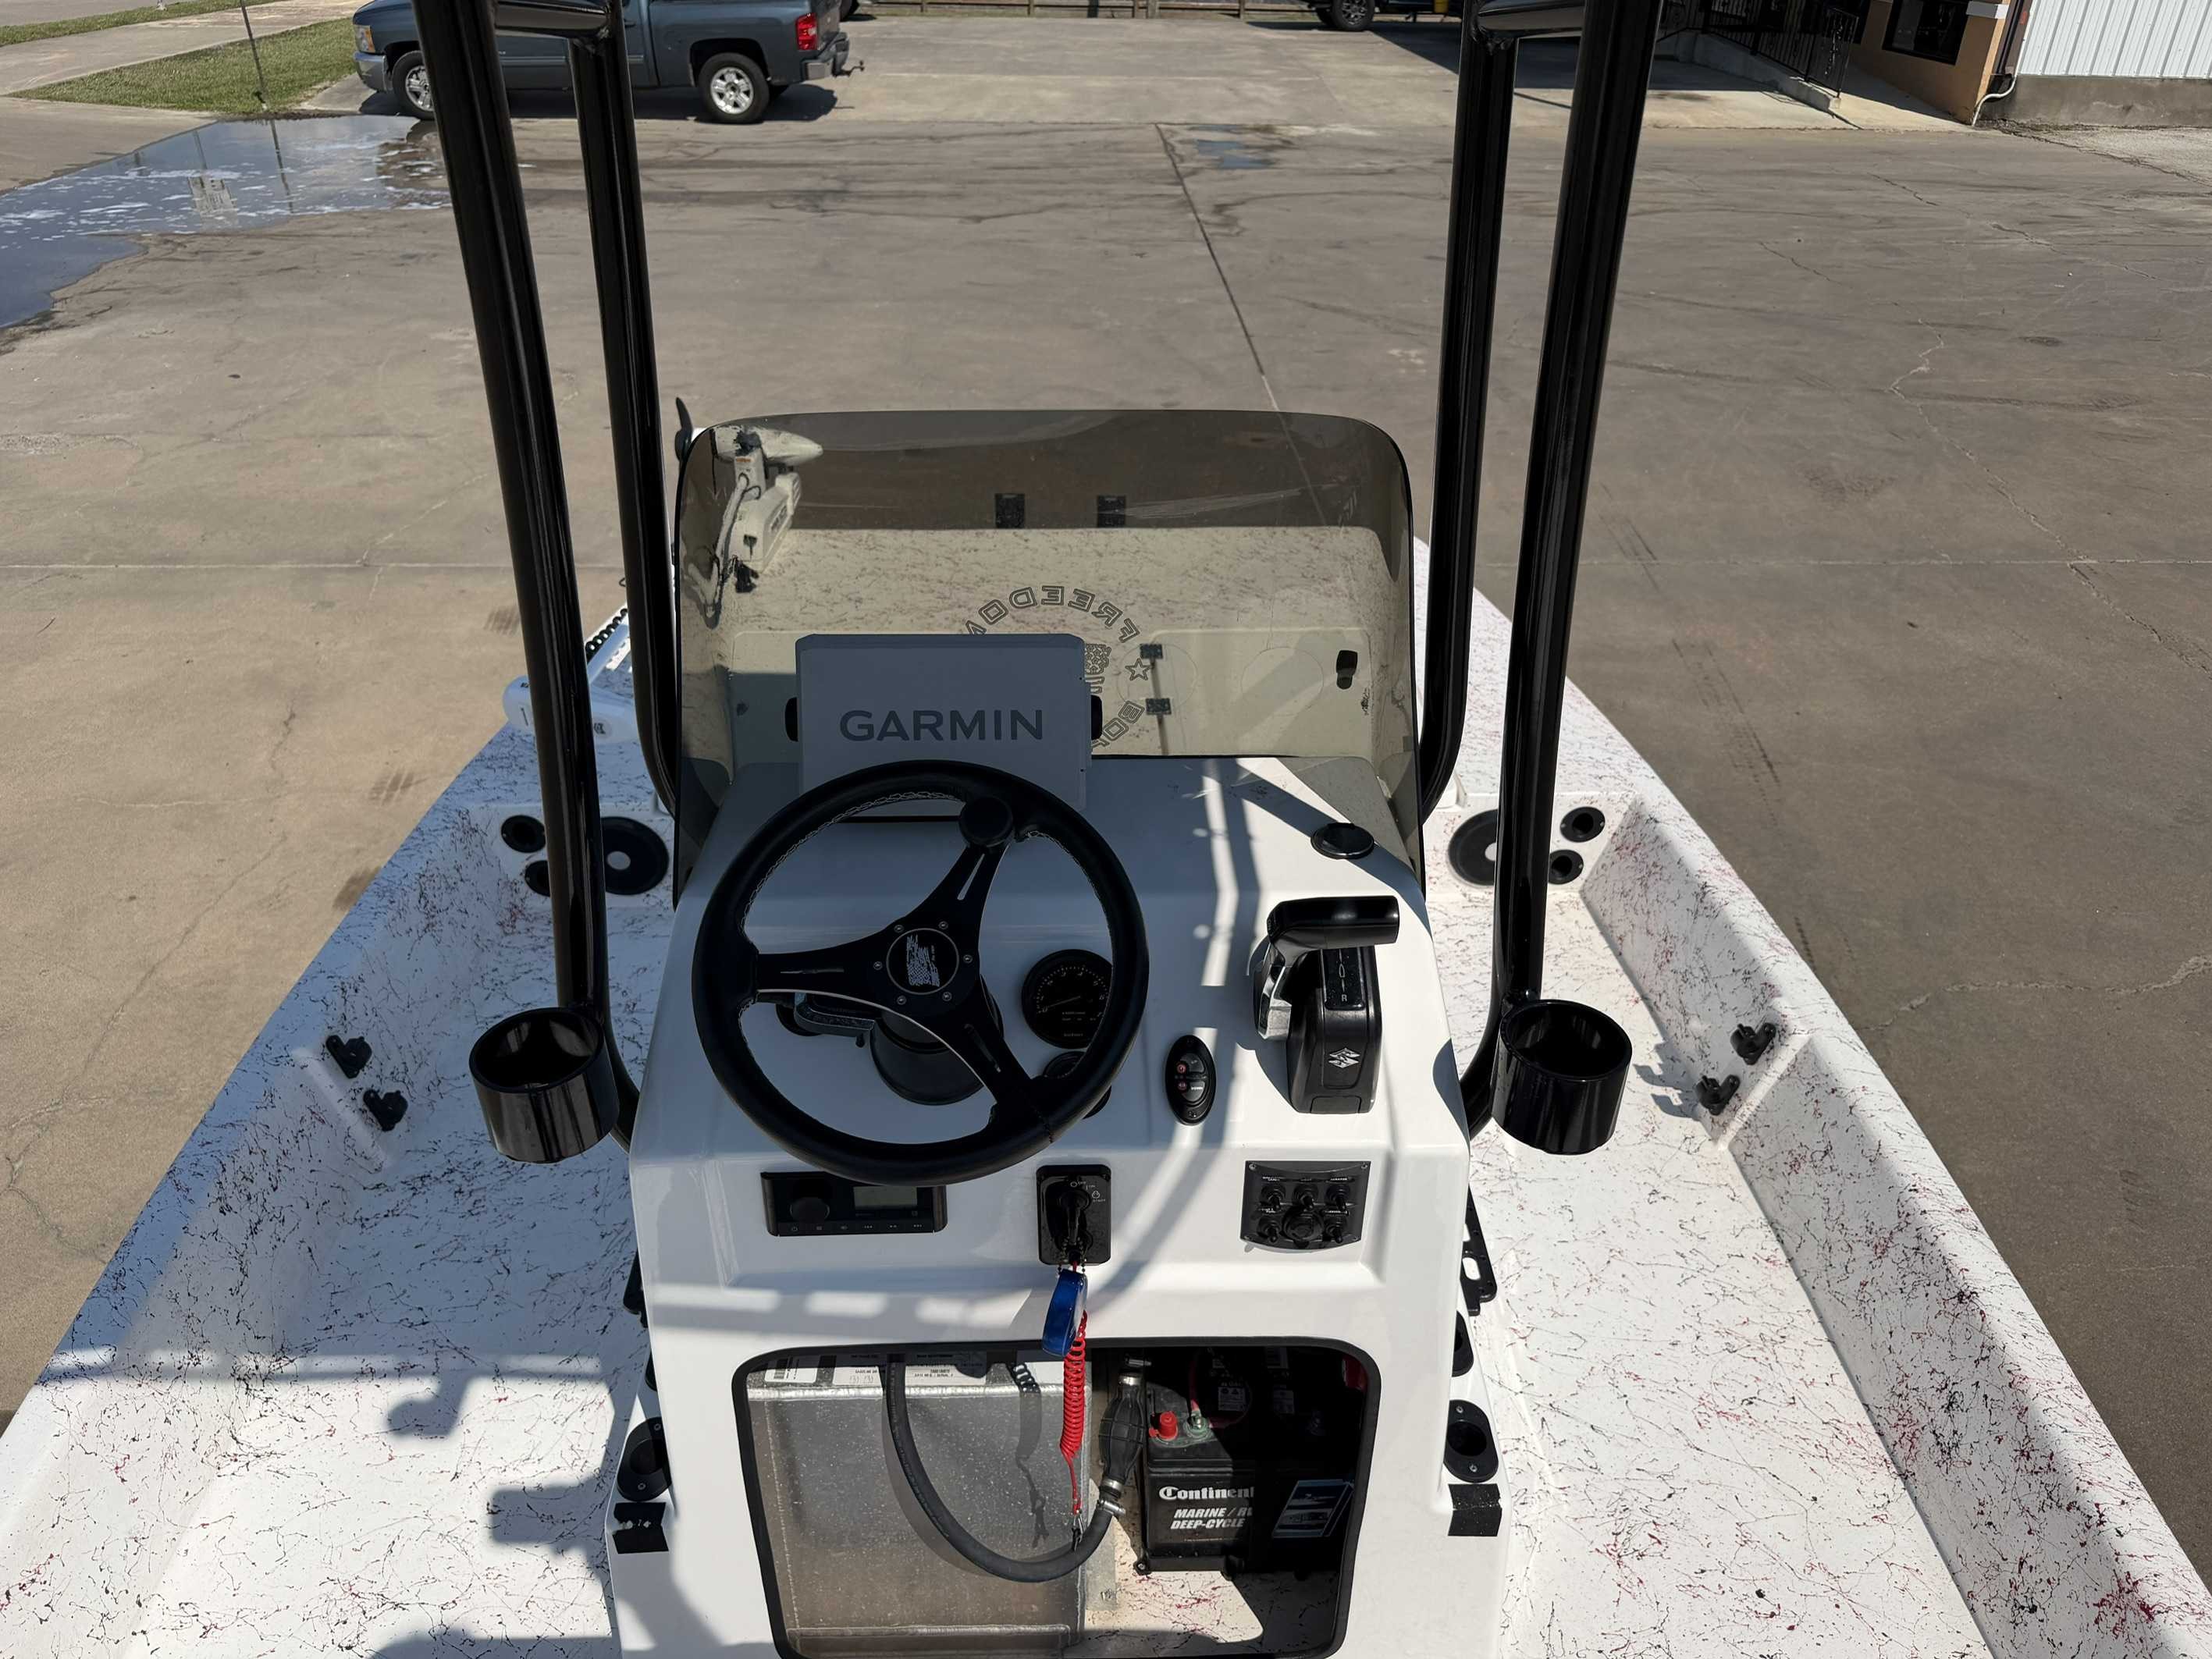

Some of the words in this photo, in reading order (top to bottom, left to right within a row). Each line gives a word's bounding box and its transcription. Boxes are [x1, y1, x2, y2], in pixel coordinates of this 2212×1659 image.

[839, 709, 1044, 741] GARMIN
[1174, 1507, 1227, 1519] MARINE
[1170, 1518, 1246, 1529] DEEP-CYCLE
